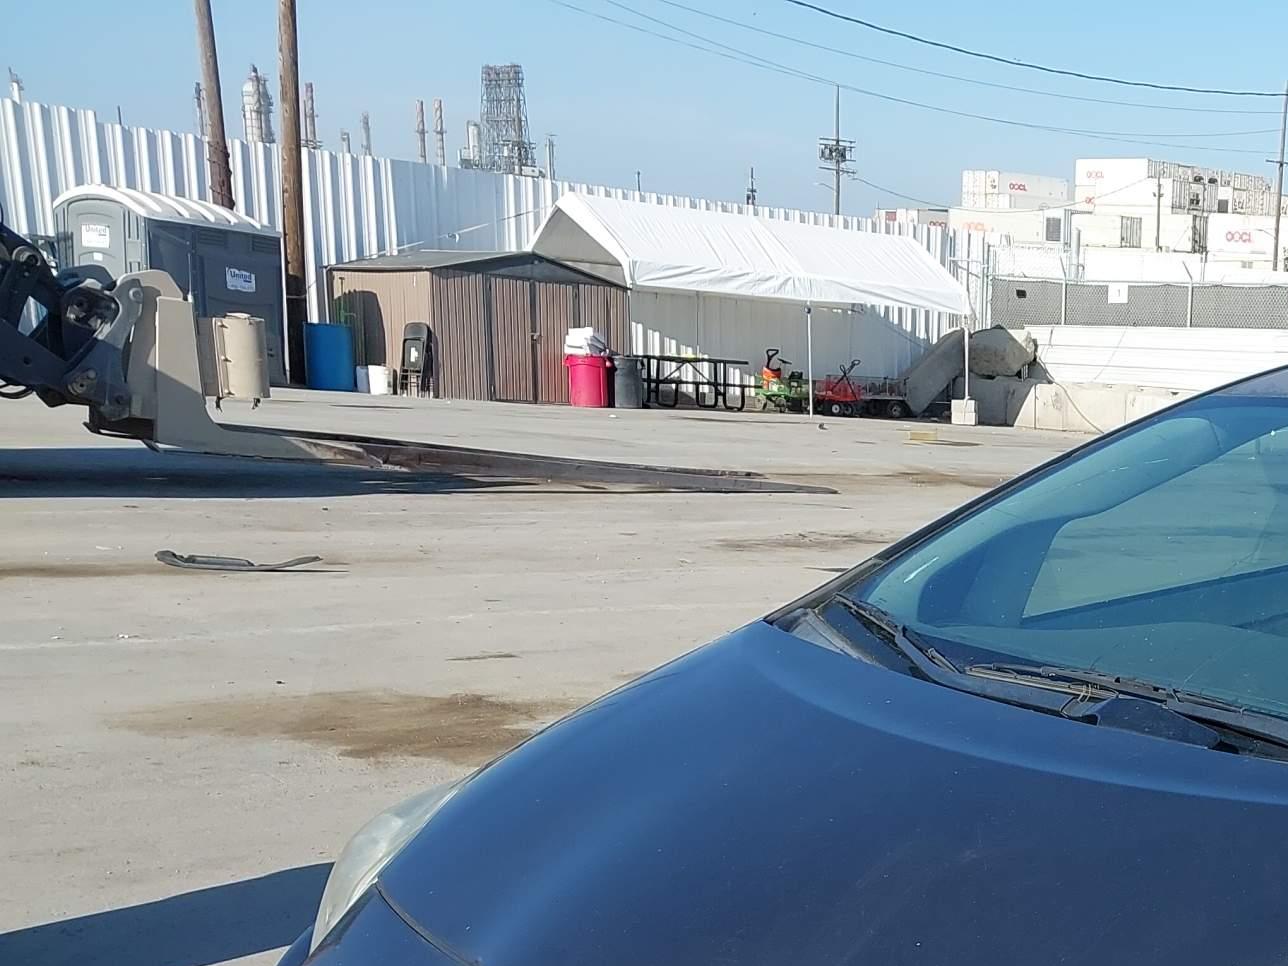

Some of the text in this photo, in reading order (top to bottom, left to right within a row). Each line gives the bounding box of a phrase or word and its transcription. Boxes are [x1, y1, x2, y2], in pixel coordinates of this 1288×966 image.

[1008, 182, 1028, 192] OOCL
[1226, 231, 1254, 243] OOCL
[230, 270, 252, 281] United
